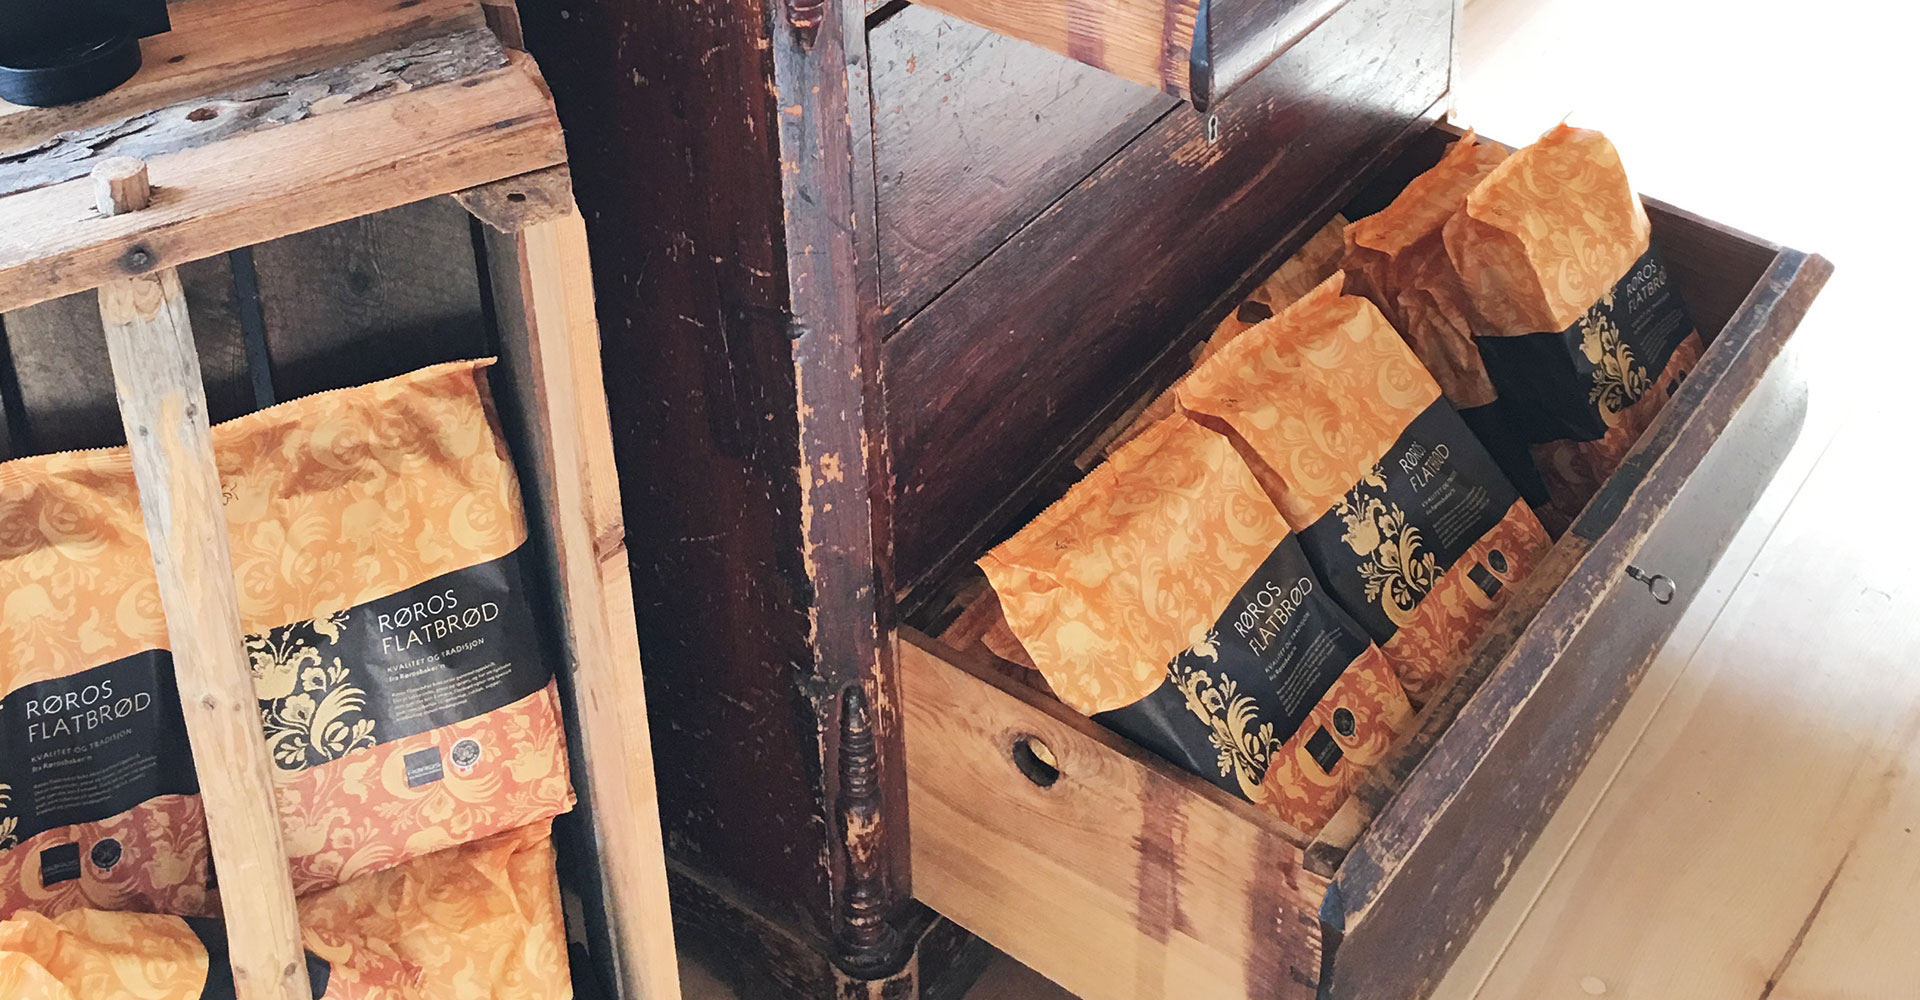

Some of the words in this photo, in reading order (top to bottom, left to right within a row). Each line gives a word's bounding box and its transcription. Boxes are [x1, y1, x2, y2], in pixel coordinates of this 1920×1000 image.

[378, 589, 458, 633] RØROS
[382, 602, 499, 655] FLATBRØD
[1234, 581, 1281, 638] RØROS
[1249, 577, 1313, 657] FLATBRØD
[387, 657, 425, 673] KVALITET
[427, 653, 441, 663] OG
[441, 637, 485, 659] TRADISJON
[26, 680, 113, 720] RØROS
[28, 692, 151, 743] FLATBRØD
[31, 747, 72, 763] KVALITET
[73, 745, 88, 754] OG
